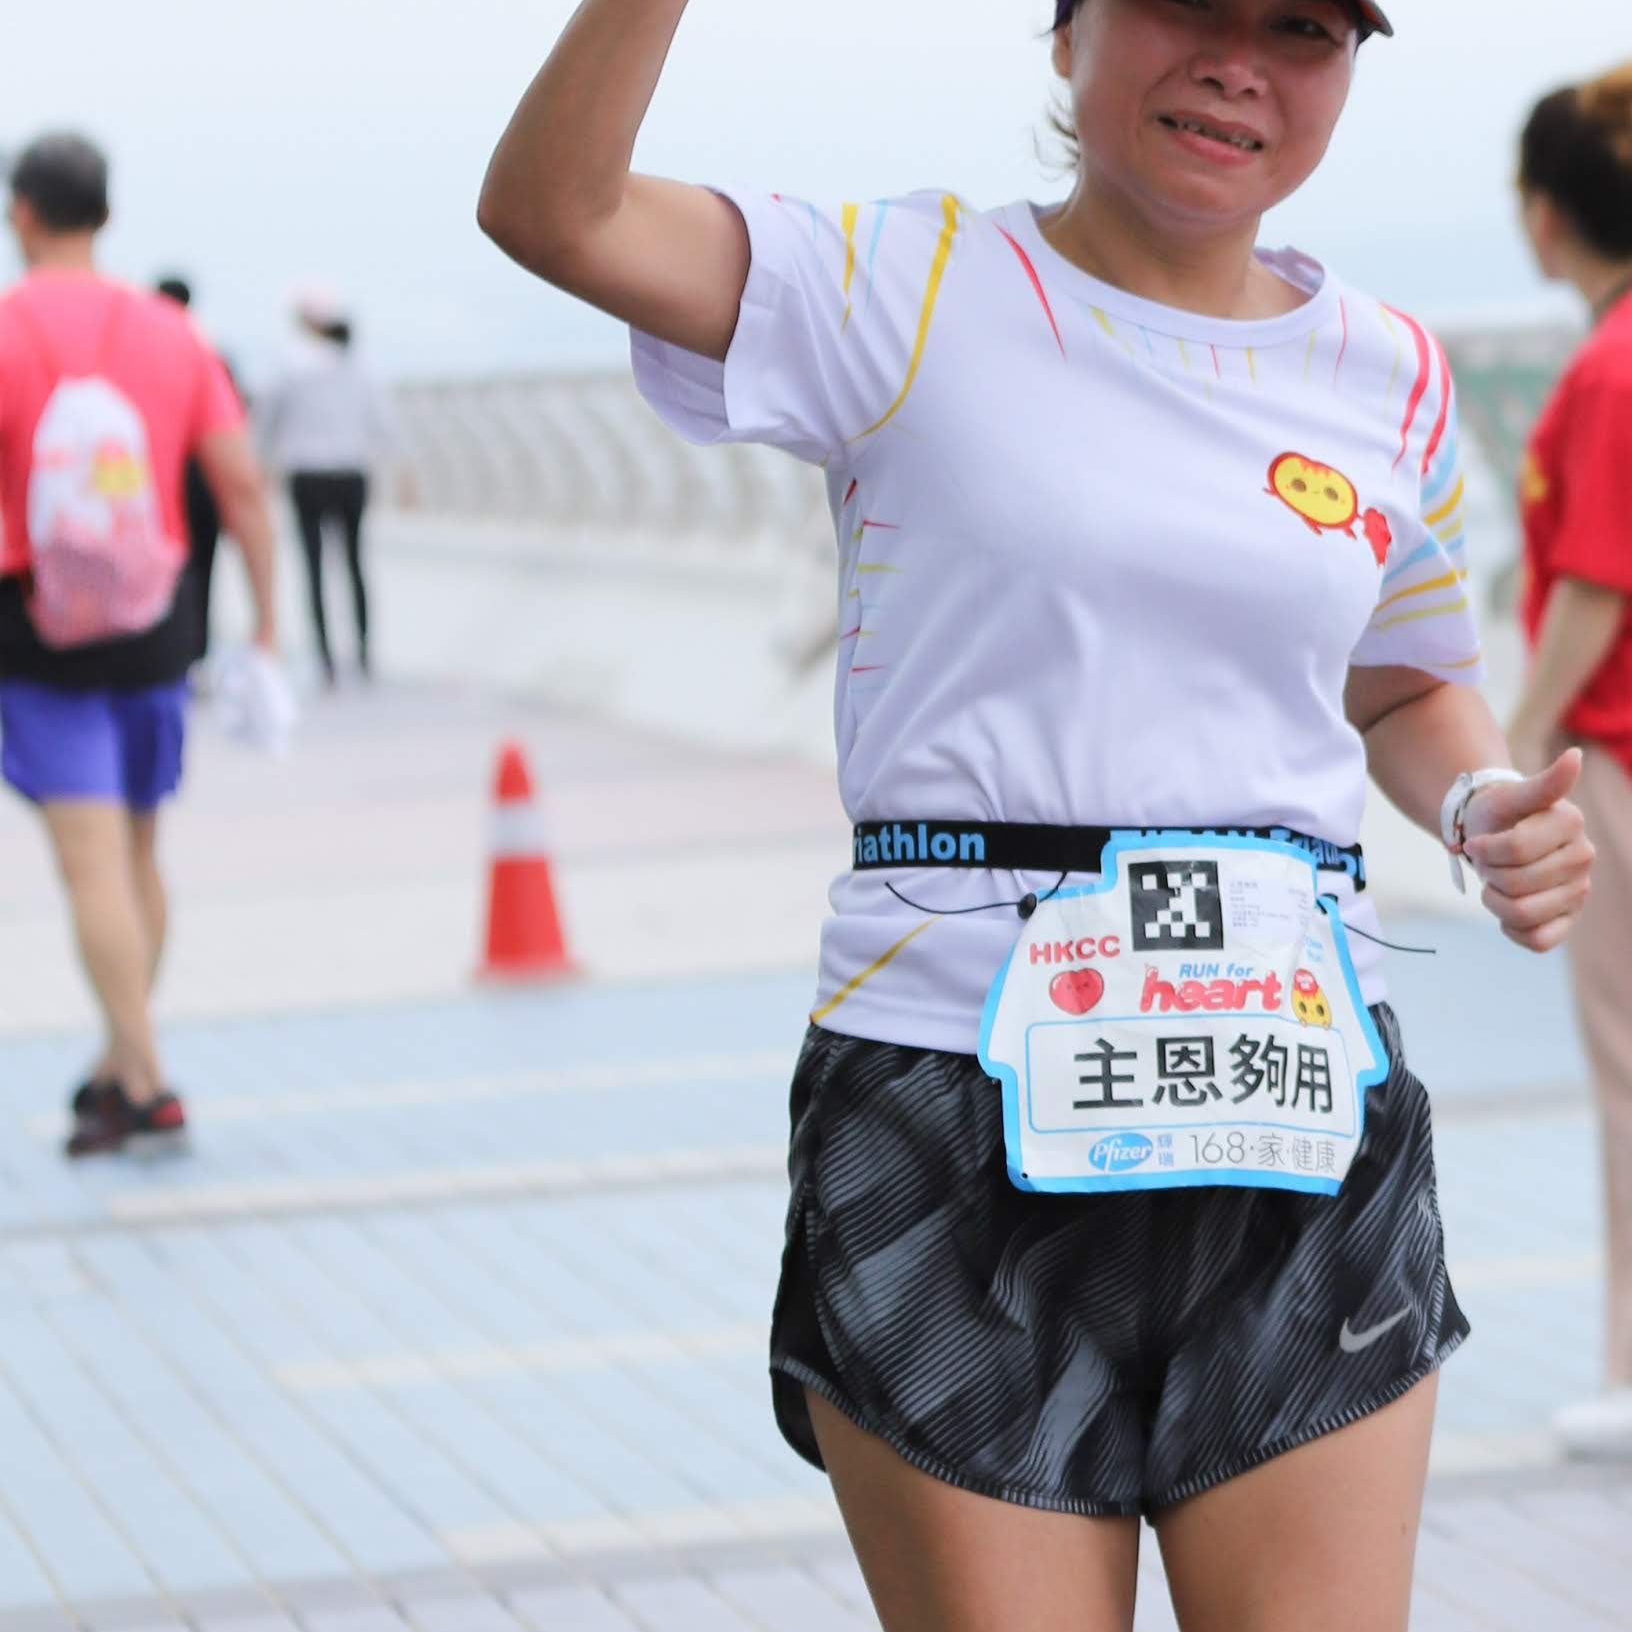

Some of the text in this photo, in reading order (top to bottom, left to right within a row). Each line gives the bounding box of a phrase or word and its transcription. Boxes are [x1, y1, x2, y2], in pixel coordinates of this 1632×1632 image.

[853, 823, 985, 862] riathlon
[1029, 935, 1121, 965] HKCC
[1140, 965, 1282, 1013] heart
[1179, 963, 1255, 979] RUN for
[1073, 1033, 1333, 1114] 主恩夠用
[1092, 1138, 1153, 1173] Pfizer
